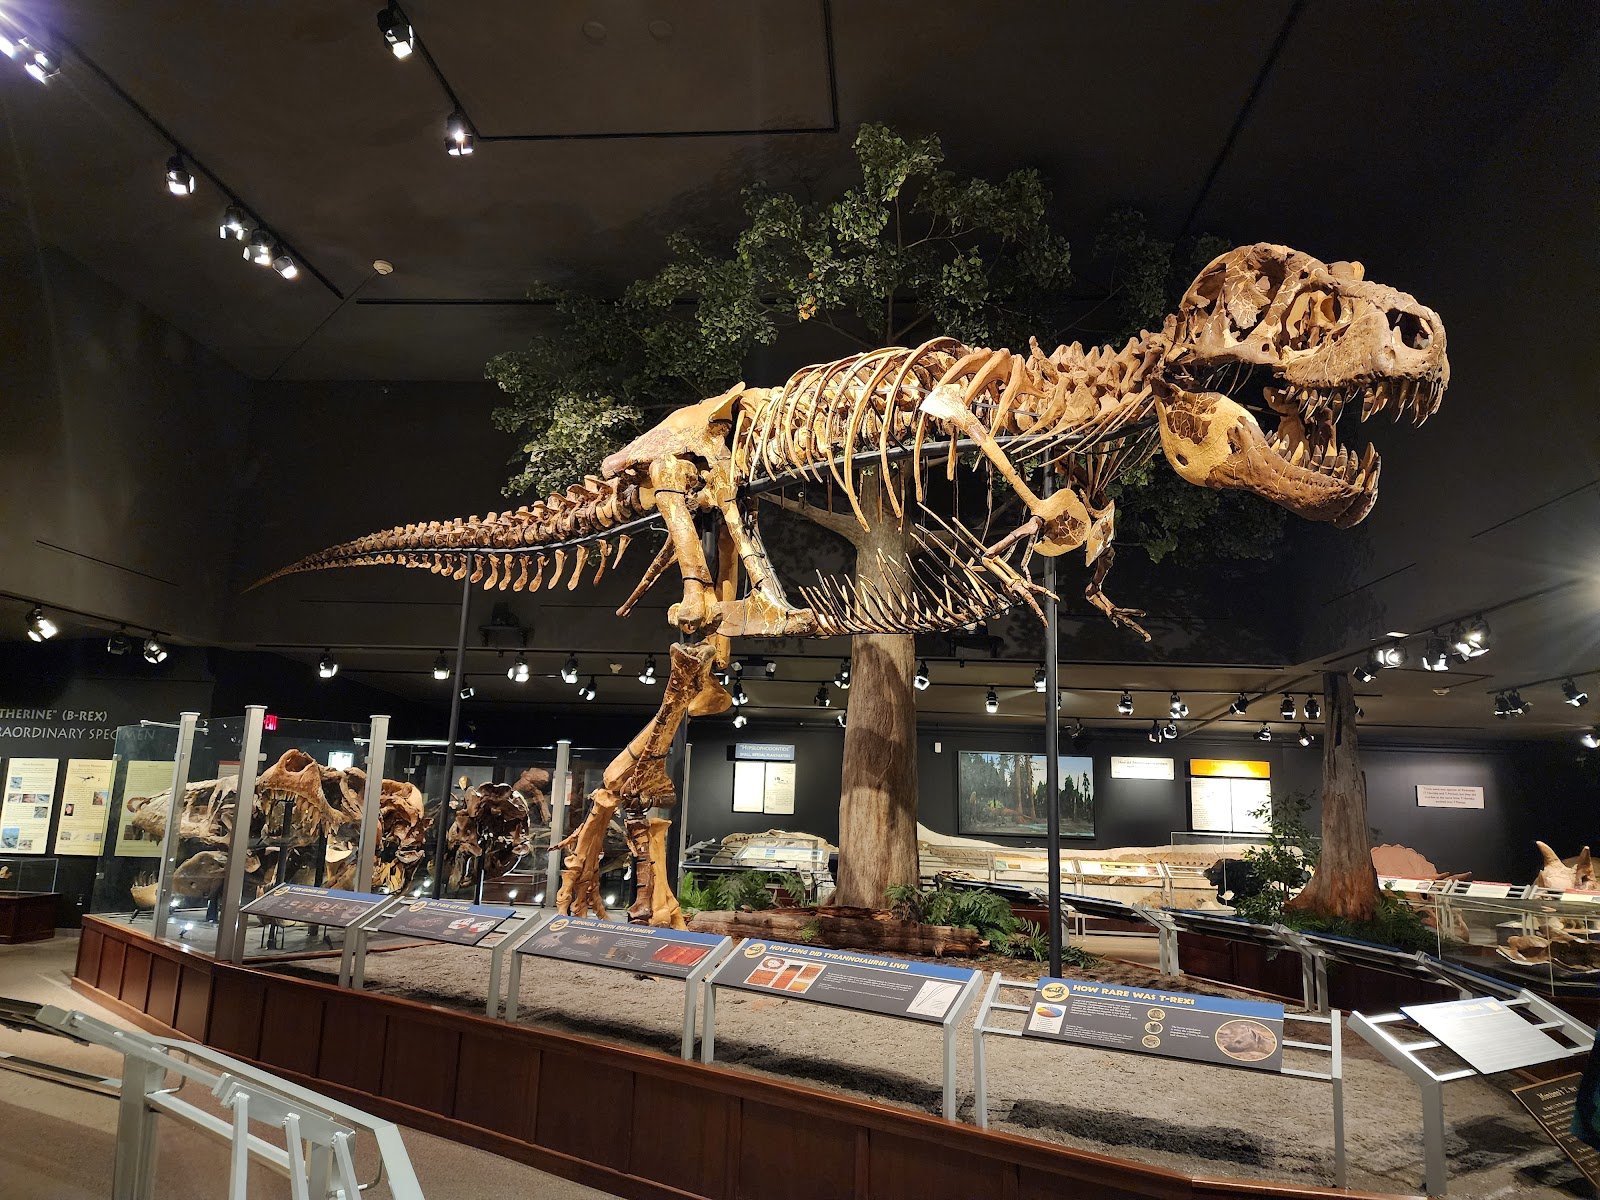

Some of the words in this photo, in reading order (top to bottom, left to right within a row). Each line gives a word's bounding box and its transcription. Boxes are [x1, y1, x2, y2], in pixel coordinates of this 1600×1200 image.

[62, 710, 108, 722] (B-REX)
[89, 728, 156, 740] SPECMEN
[787, 947, 809, 955] LONG
[823, 952, 888, 967] TYRANNOSAURUS
[1072, 984, 1100, 993] HOW
[1100, 987, 1130, 997] RARE
[1131, 991, 1157, 1000] WAS
